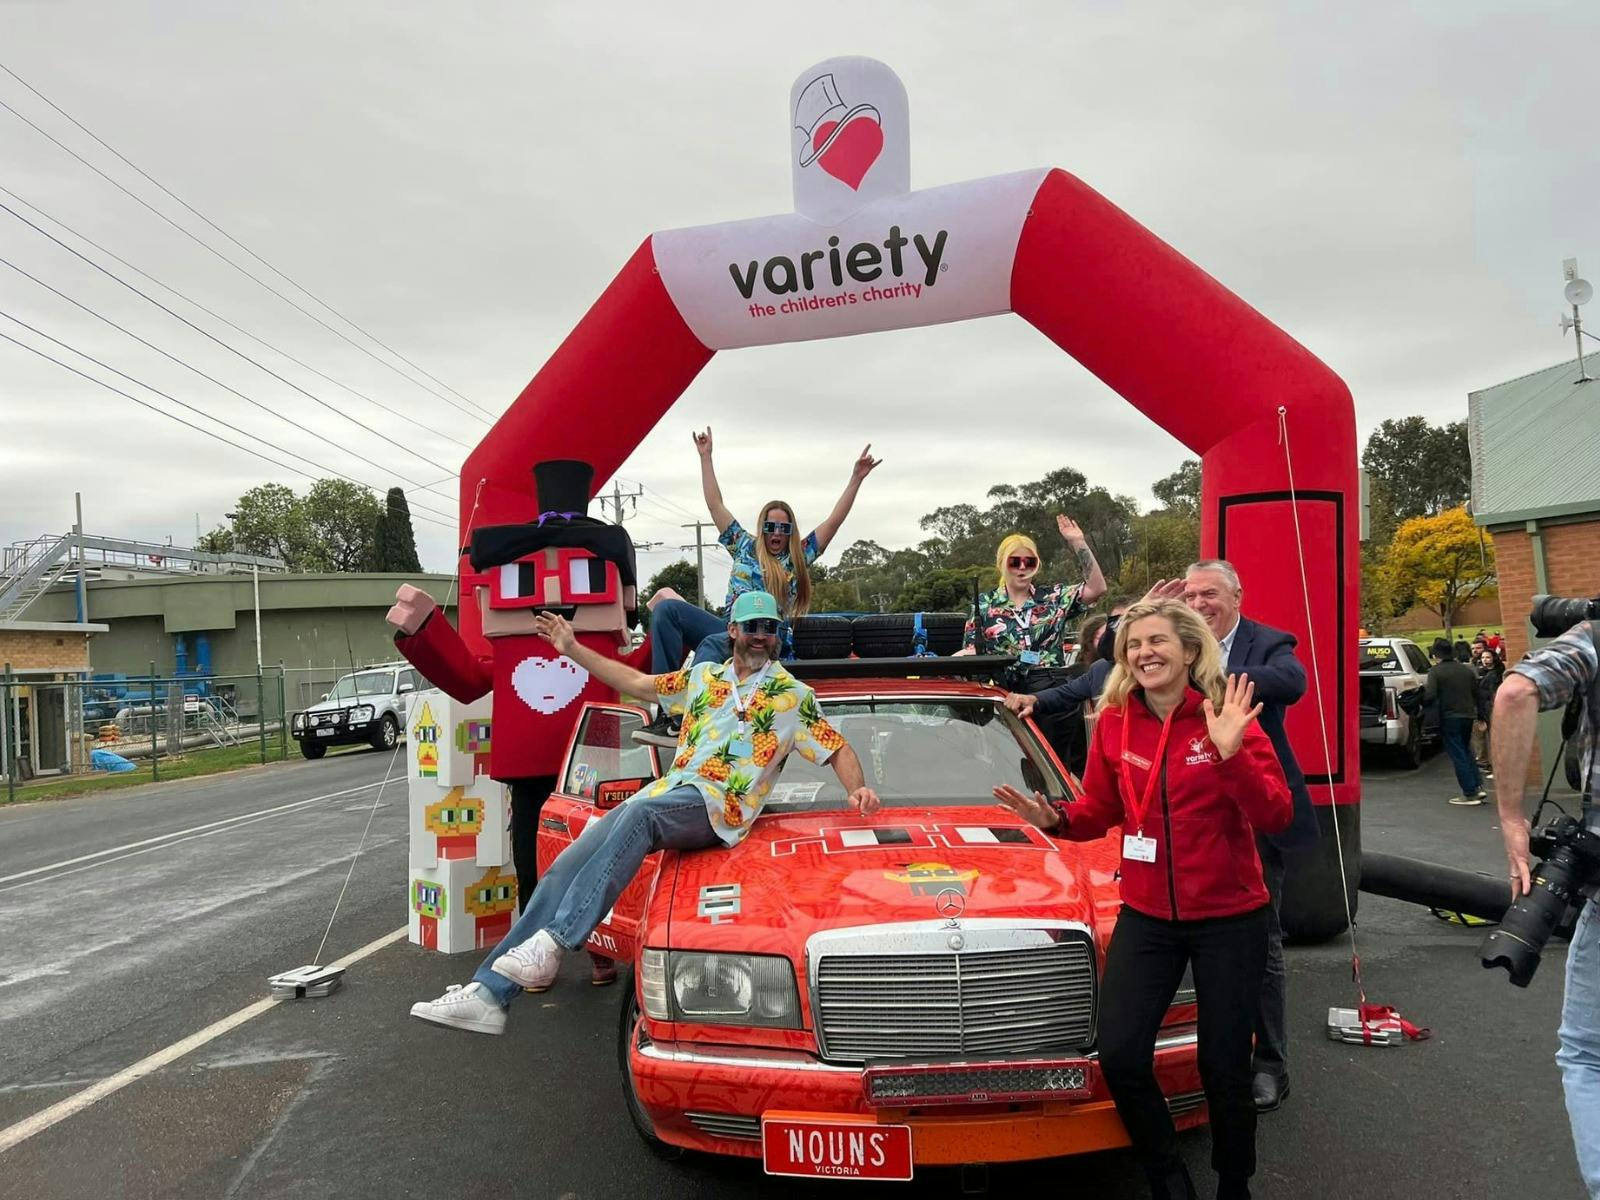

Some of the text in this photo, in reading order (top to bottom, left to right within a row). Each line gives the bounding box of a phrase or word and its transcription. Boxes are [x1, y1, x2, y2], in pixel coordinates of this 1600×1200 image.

[728, 225, 948, 299] variety
[748, 282, 922, 318] the children's charity
[789, 1128, 886, 1167] NOUNS
[815, 1165, 860, 1175] VICTORIA
